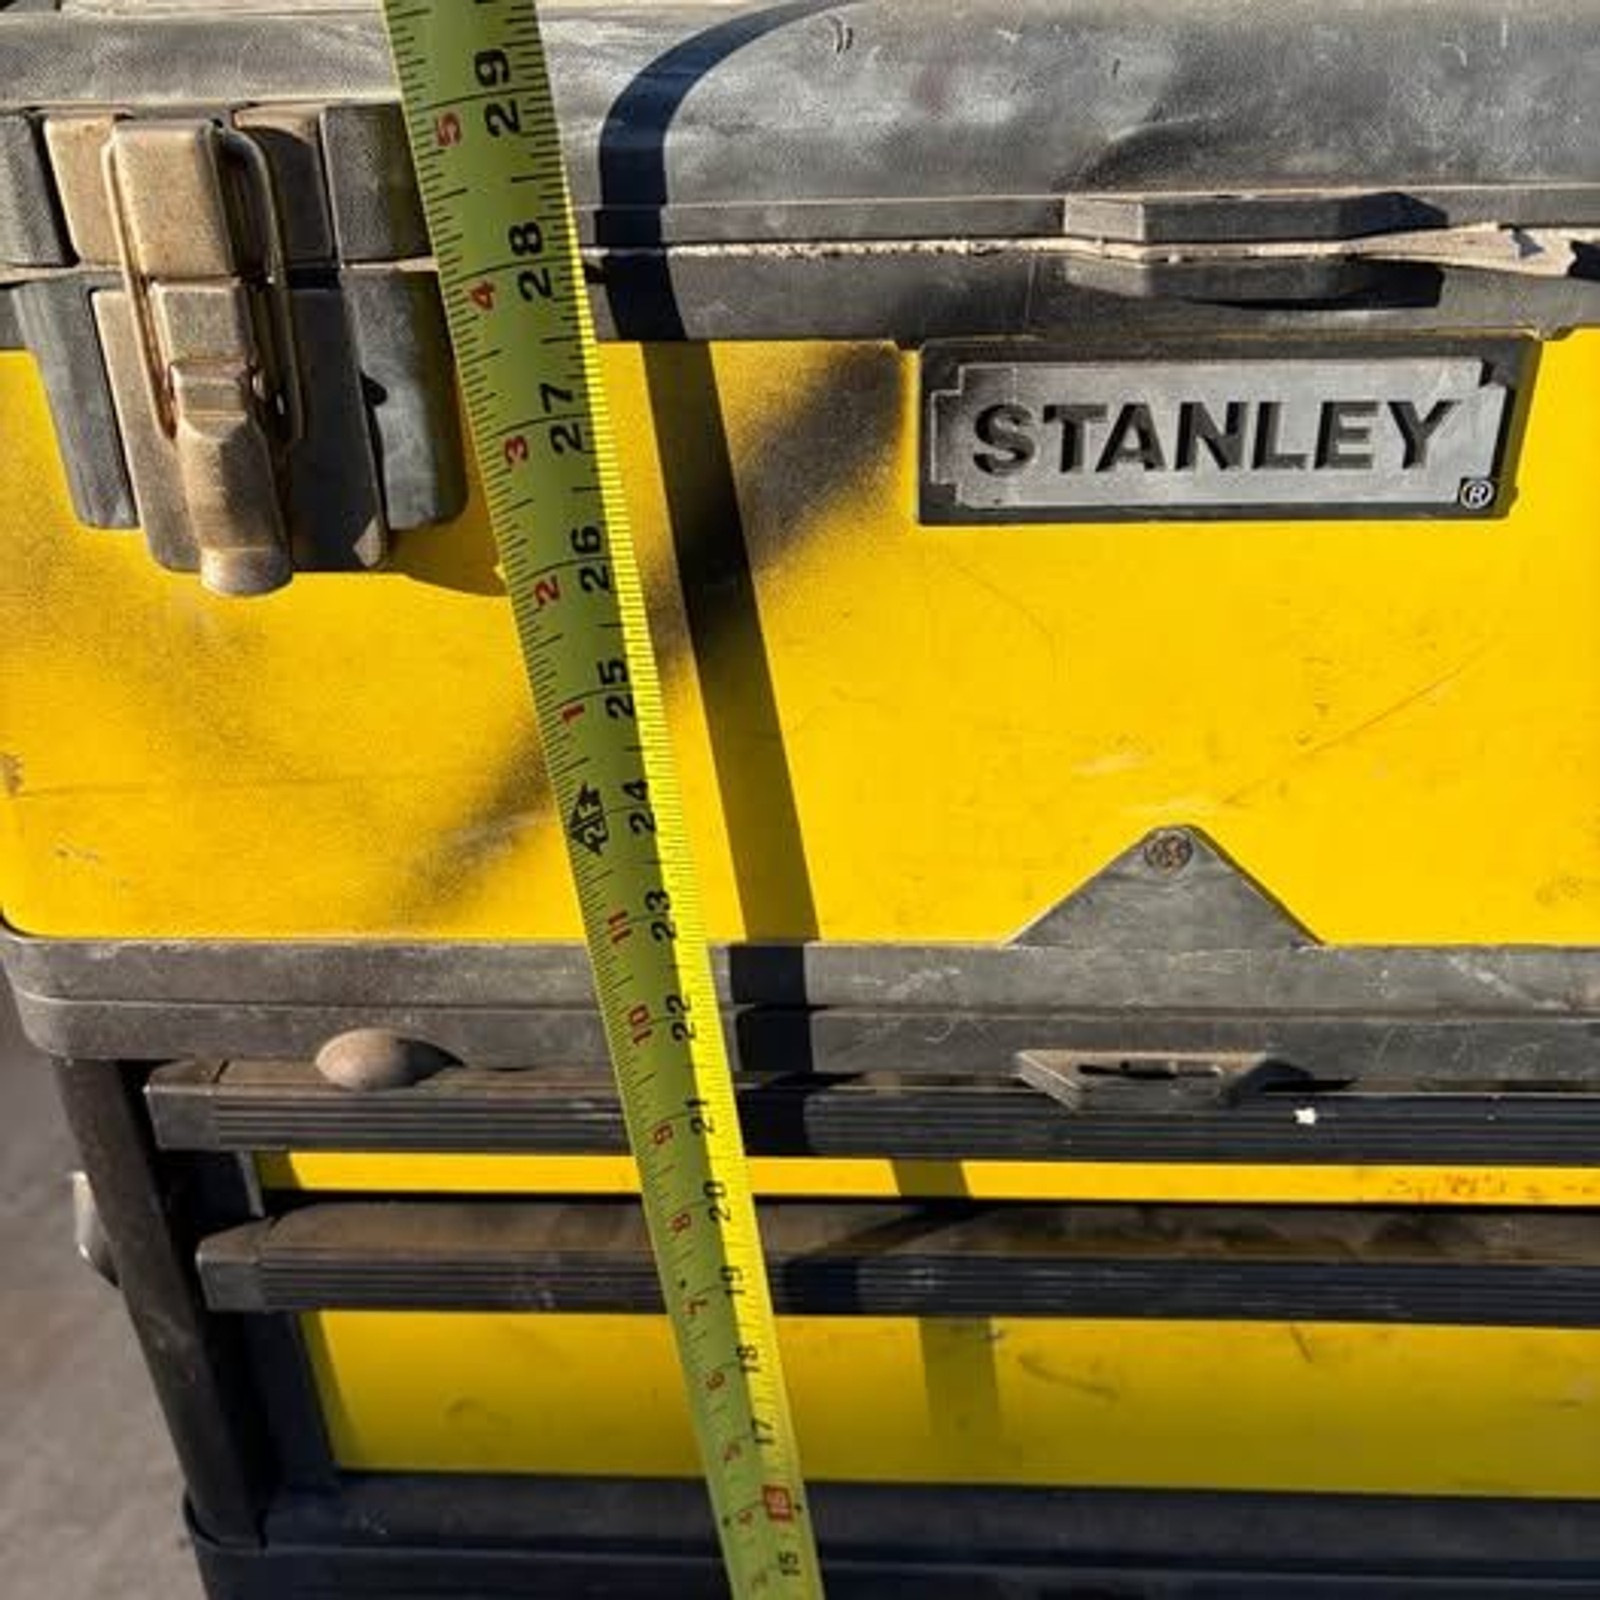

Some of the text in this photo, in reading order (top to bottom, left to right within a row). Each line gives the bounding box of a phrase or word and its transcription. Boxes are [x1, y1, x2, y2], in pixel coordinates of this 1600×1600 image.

[474, 49, 521, 137] 29
[435, 112, 463, 147] 5
[508, 221, 555, 301] 28
[470, 281, 496, 311] 4
[538, 383, 583, 454] 27
[972, 398, 1463, 476] STANLEY
[503, 435, 529, 464] 3
[570, 526, 611, 592] 26
[534, 575, 561, 606] 2
[597, 658, 635, 720] 25
[560, 703, 586, 724] 1
[622, 779, 657, 835] 24
[607, 910, 633, 945] 11
[644, 890, 677, 942] 23
[628, 1005, 653, 1045] 10
[666, 994, 697, 1041] 22
[684, 1098, 715, 1134] 21
[702, 1180, 732, 1222] 20
[719, 1266, 746, 1296] 19
[736, 1344, 761, 1373] 18
[751, 1417, 774, 1446] 17
[778, 1551, 801, 1577] 15
